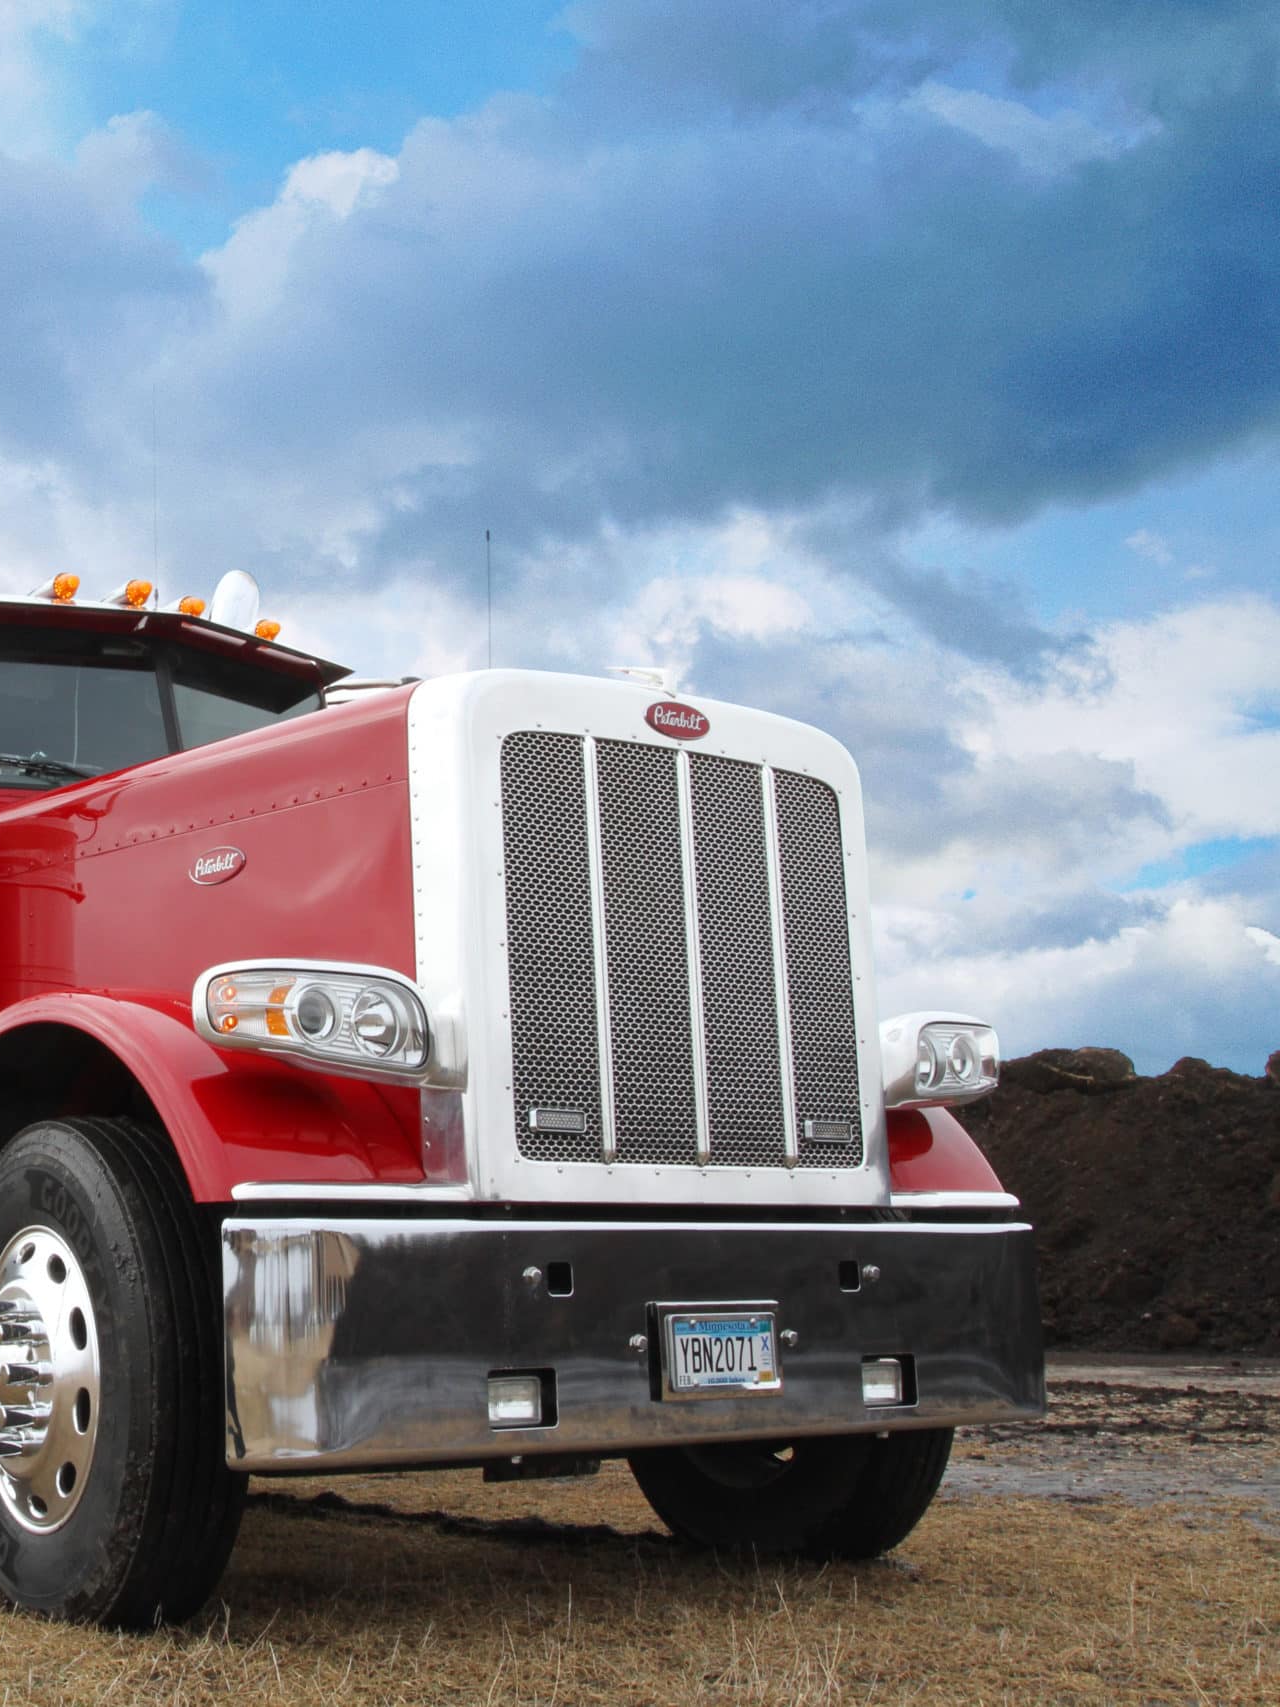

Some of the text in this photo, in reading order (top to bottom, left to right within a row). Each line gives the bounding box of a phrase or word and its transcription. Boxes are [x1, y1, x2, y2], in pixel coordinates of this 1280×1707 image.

[654, 705, 705, 730] Peterbilt
[195, 852, 239, 878] Peterbilt
[698, 1321, 745, 1331] Minnesota
[680, 1335, 758, 1374] YBN2071
[679, 1375, 691, 1386] FEB
